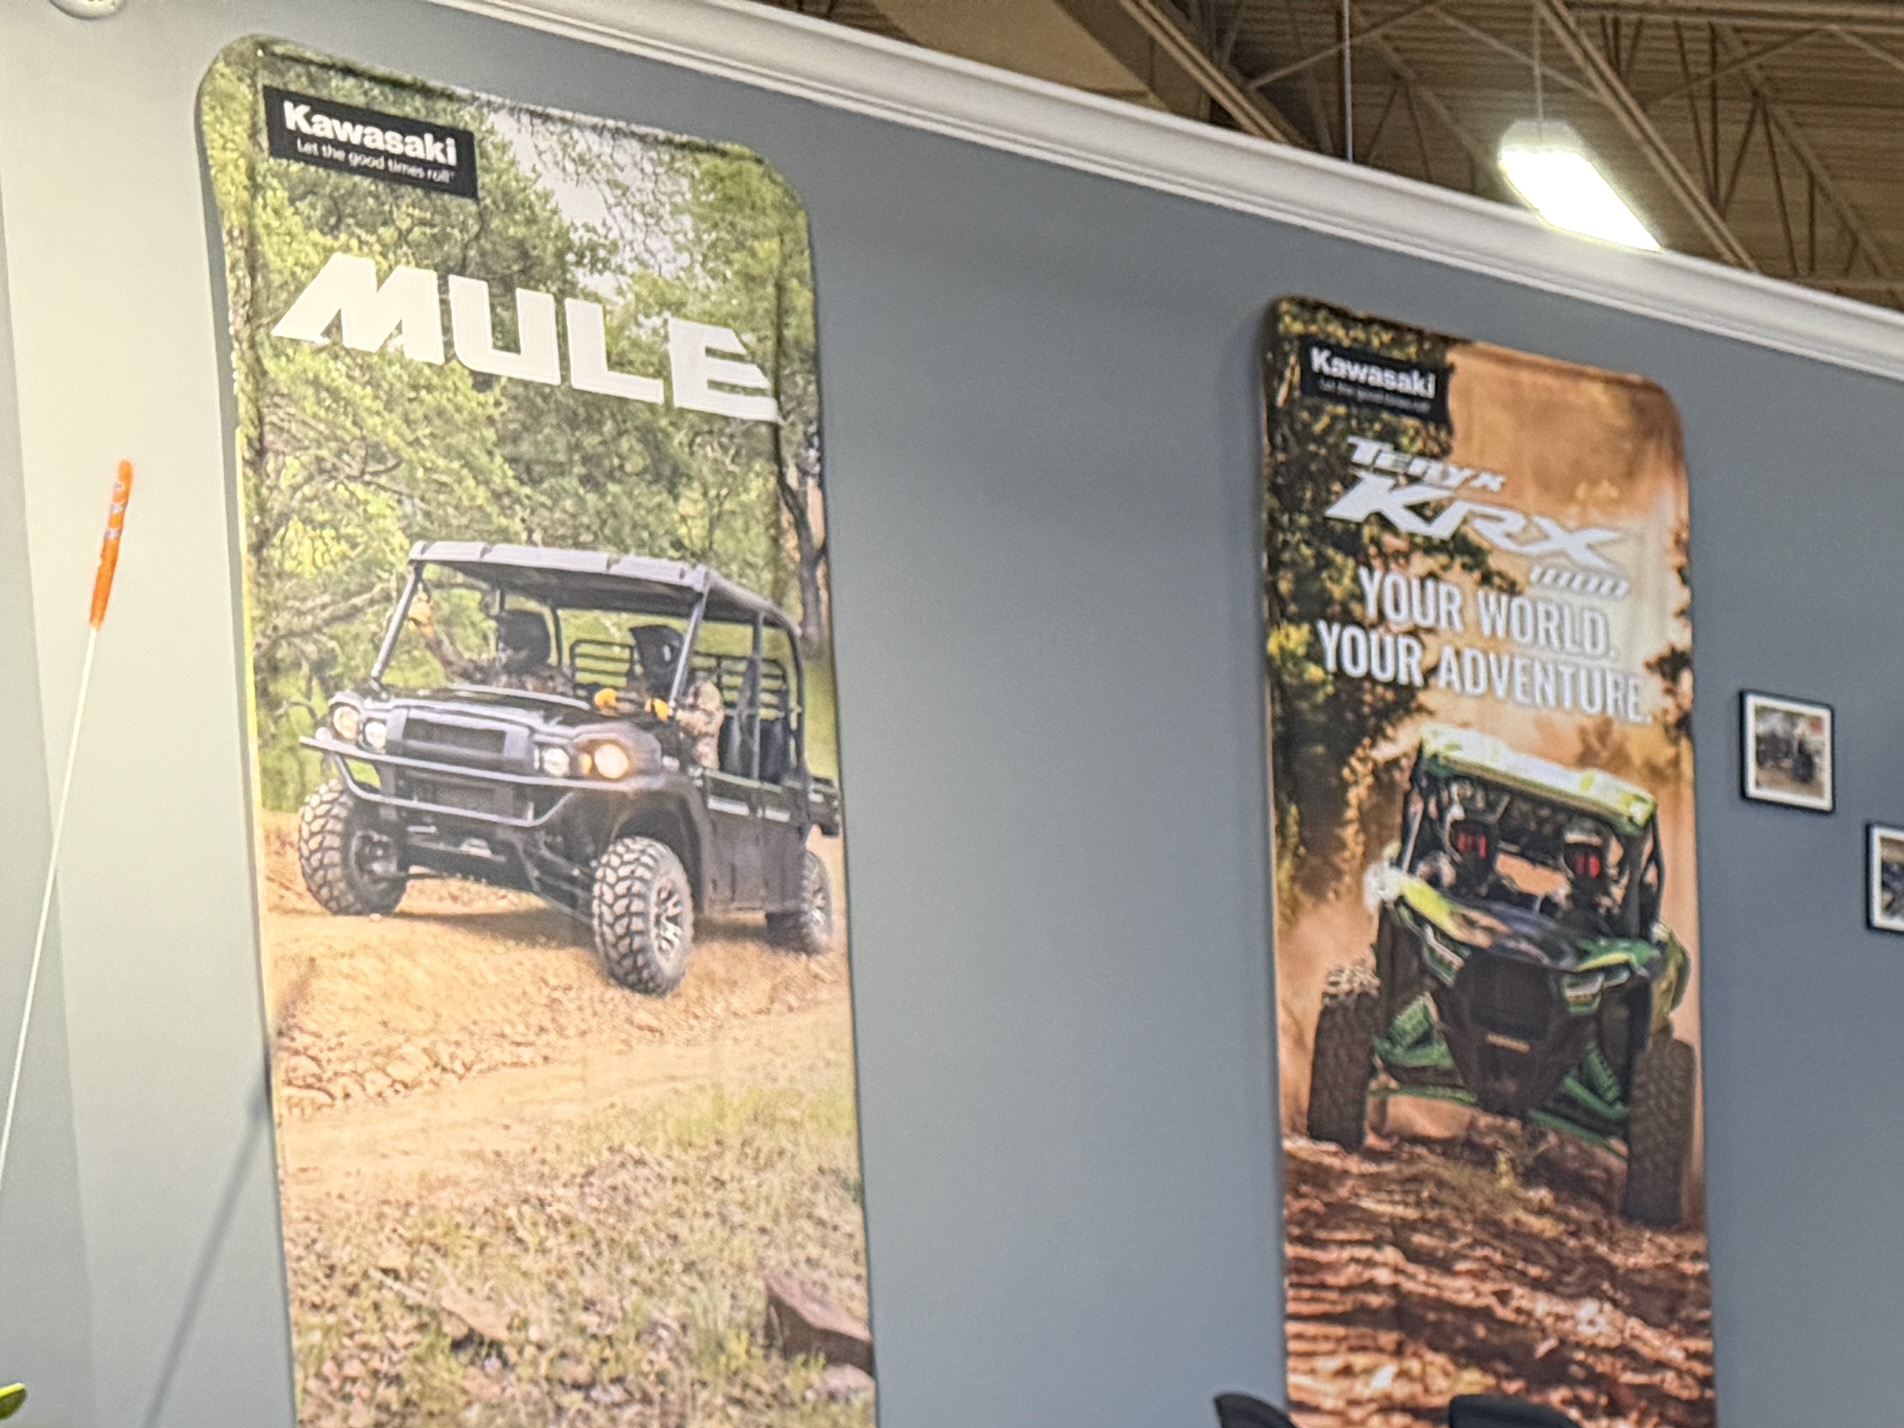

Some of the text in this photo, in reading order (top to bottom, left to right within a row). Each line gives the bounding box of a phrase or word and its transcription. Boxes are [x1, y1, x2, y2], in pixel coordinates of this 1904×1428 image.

[283, 100, 457, 166] Kawasaki
[348, 152, 385, 169] good
[271, 252, 784, 424] MULE
[1310, 347, 1436, 399] Kawasaki
[1324, 469, 1624, 570] KRX
[1358, 565, 1617, 657] YOUR WORLD.
[1316, 618, 1653, 724] YOUR ADVENTURE.
